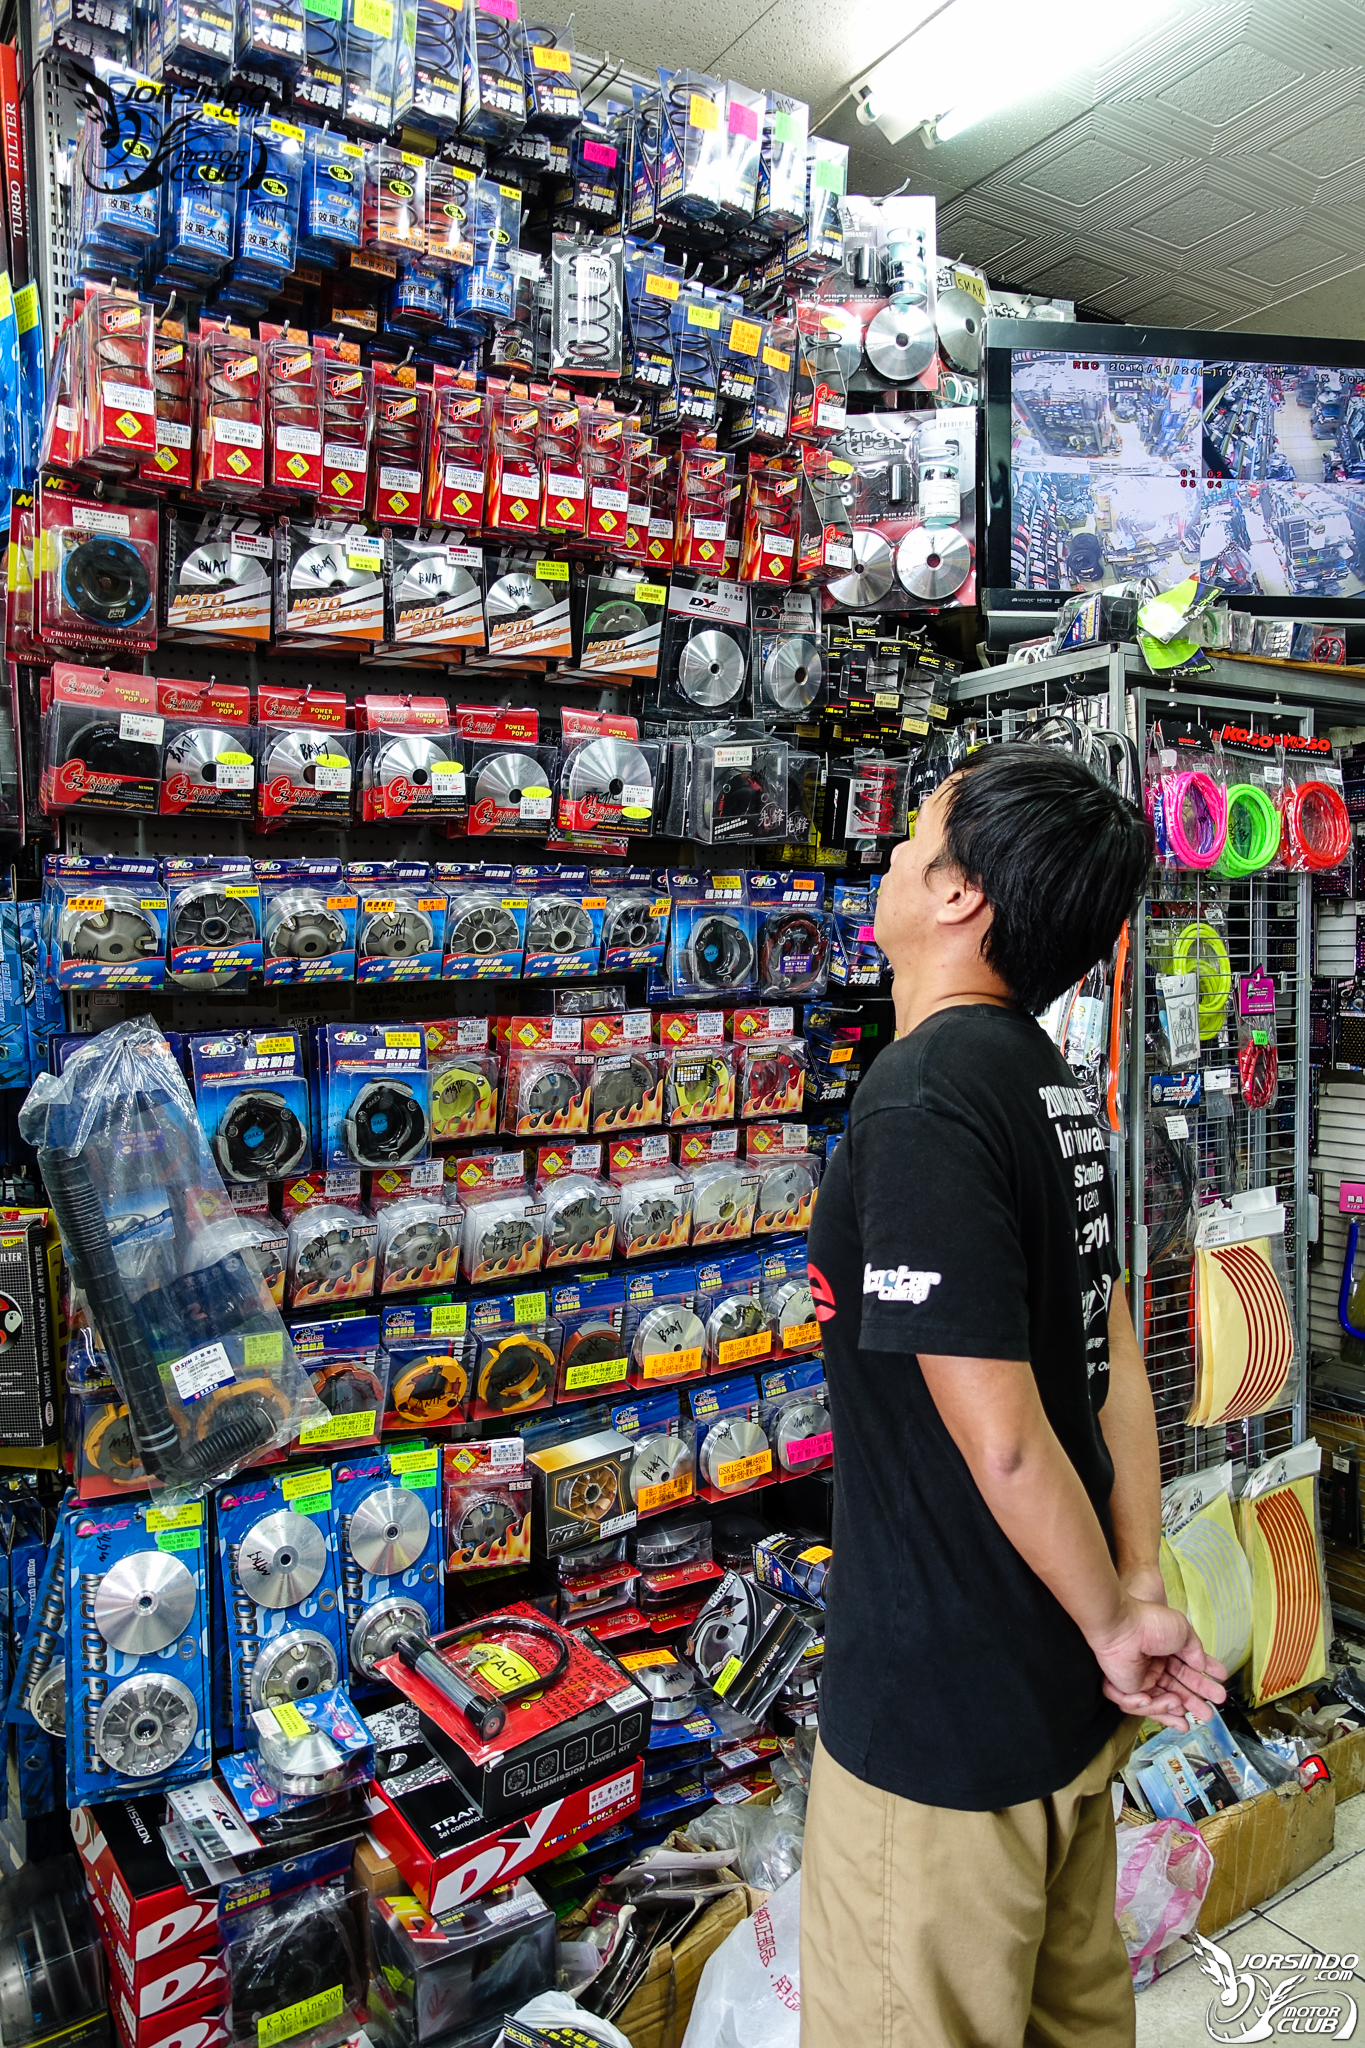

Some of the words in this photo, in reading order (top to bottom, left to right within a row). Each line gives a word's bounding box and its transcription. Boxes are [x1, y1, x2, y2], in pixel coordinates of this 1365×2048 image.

[6, 102, 20, 171] FILTER
[12, 180, 24, 238] TURBO
[957, 277, 985, 300] SMAX
[1073, 360, 1099, 370] REC
[1181, 469, 1196, 478] 01
[1208, 470, 1222, 479] 02
[45, 477, 81, 492] NCY
[1181, 479, 1196, 488] 03
[1208, 480, 1222, 489] 04
[173, 594, 226, 609] MOTO
[292, 597, 341, 613] MOTO
[185, 606, 259, 621] SPORTS
[304, 608, 373, 625] SPORTS
[399, 606, 444, 623] MOTO
[410, 614, 474, 635] SPORTS
[492, 619, 534, 637] MOTO
[503, 627, 560, 647] SPORTS
[586, 639, 626, 653] MOTO
[594, 649, 650, 666] SPORTS
[115, 687, 140, 697] POWER
[123, 694, 139, 703] POP
[211, 700, 235, 709] POWER
[218, 707, 233, 716] POP
[233, 708, 244, 716] UP
[504, 723, 525, 731] POWER
[608, 728, 628, 737] POWER
[1223, 725, 1274, 747] KOSO
[1283, 736, 1331, 752] KOSO
[757, 808, 784, 827] 先鋒
[1173, 1028, 1191, 1045] VIP
[34, 1245, 45, 1280] FILTER
[36, 1280, 46, 1294] AIR
[436, 1306, 461, 1315] RS100
[36, 1297, 50, 1368] PERFORMANCE
[180, 1359, 193, 1368] SYM
[80, 1573, 108, 1672] MOTOR
[491, 1653, 525, 1684] TACH
[82, 1676, 110, 1775] POWER
[520, 1764, 586, 1798] TRANSMISSION
[587, 1750, 616, 1768] POWER
[617, 1744, 632, 1756] KIT
[438, 1826, 450, 1840] Set
[430, 1798, 565, 1916] DY
[266, 1987, 343, 2029] K-Xciting300
